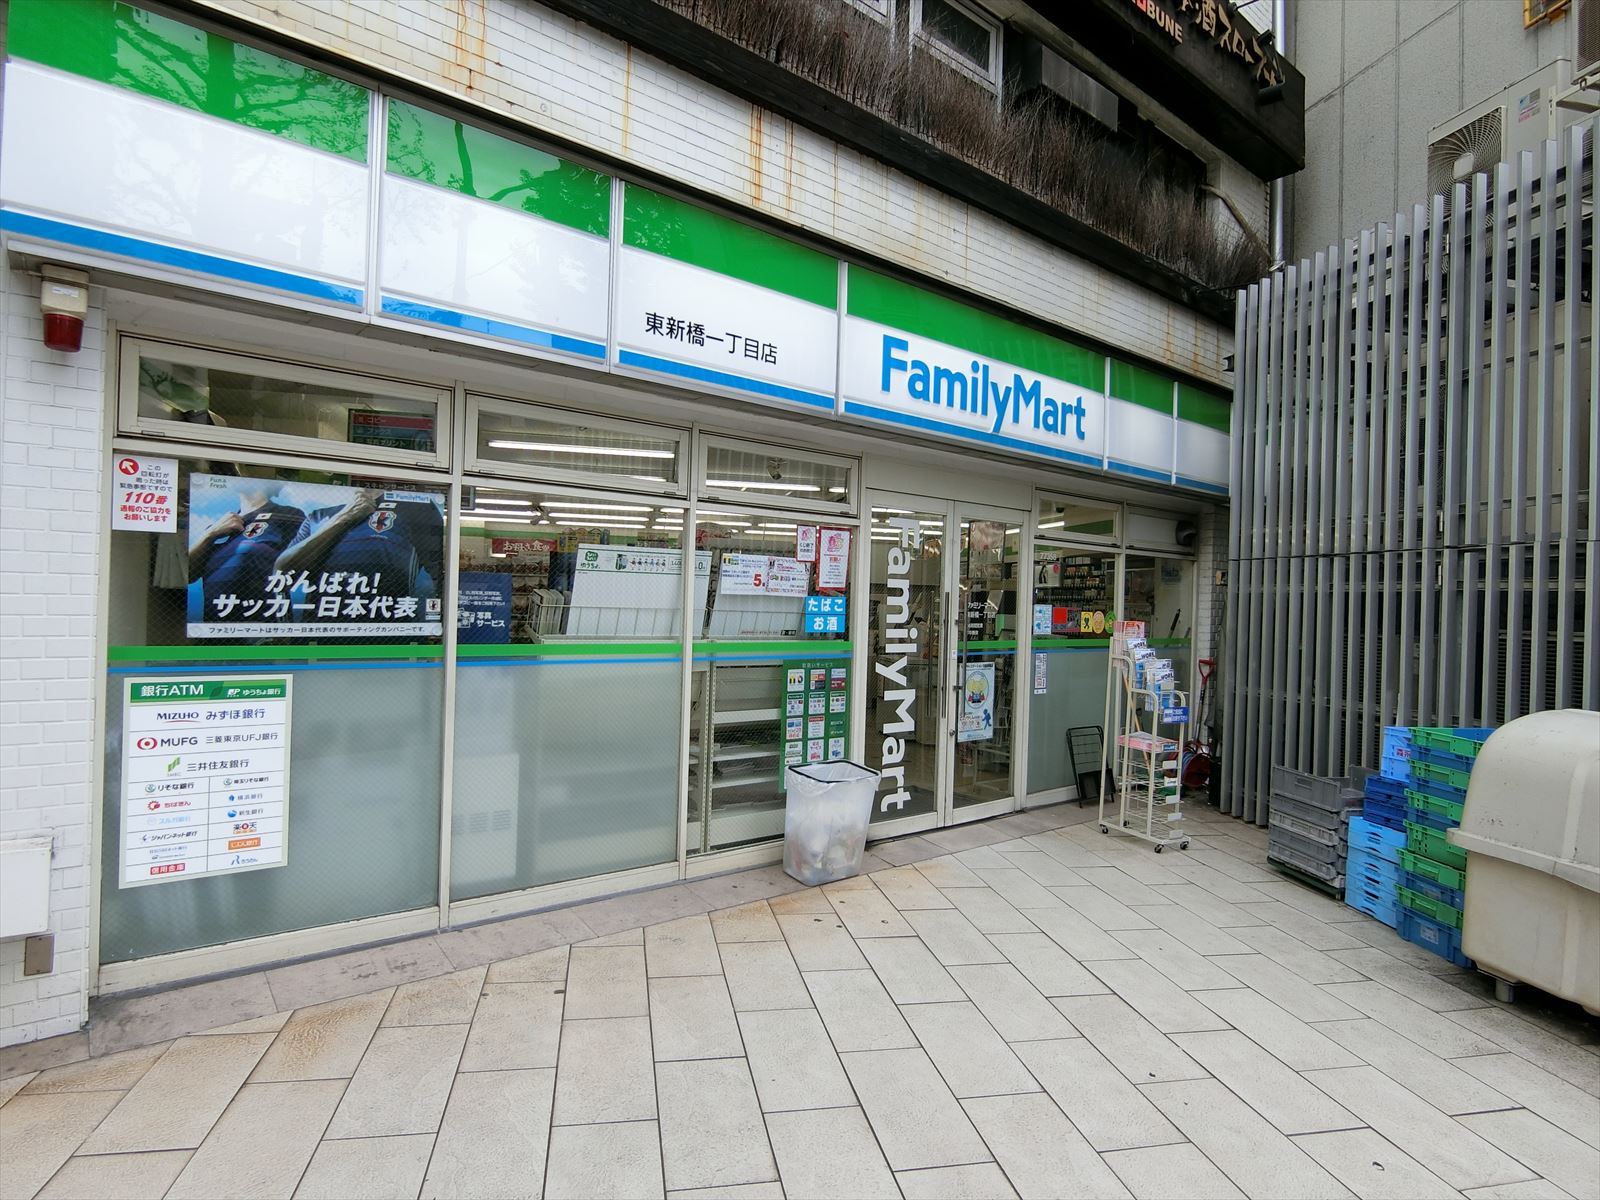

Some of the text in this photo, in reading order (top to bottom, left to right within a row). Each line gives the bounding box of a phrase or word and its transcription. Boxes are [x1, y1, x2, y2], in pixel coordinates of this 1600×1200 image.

[645, 312, 778, 365] 東新橋一丁目店
[881, 334, 1086, 441] FamilyMart
[125, 491, 168, 505] 110番
[395, 493, 429, 502] FamilyMart
[120, 504, 172, 515] 通報のご協力を
[123, 513, 168, 522] お願いします
[212, 593, 419, 619] サッカー日本代表
[808, 598, 844, 612] たばこ
[476, 619, 506, 627] サービス
[813, 616, 838, 631] お酒
[875, 515, 920, 813] FamilyMart
[141, 684, 204, 697] 銀行ATM
[242, 687, 281, 696] ゆうちょ銀行
[156, 709, 266, 720] MIZUHO みずほ銀行
[160, 732, 279, 747] MUFG 三菱東京UFJ銀行
[187, 759, 250, 772] 三井住友銀行
[157, 781, 194, 791] りそな銀行
[237, 792, 264, 801] 横浜銀行
[238, 808, 264, 817] 新生銀行
[150, 830, 198, 842] ジャパンネット銀行
